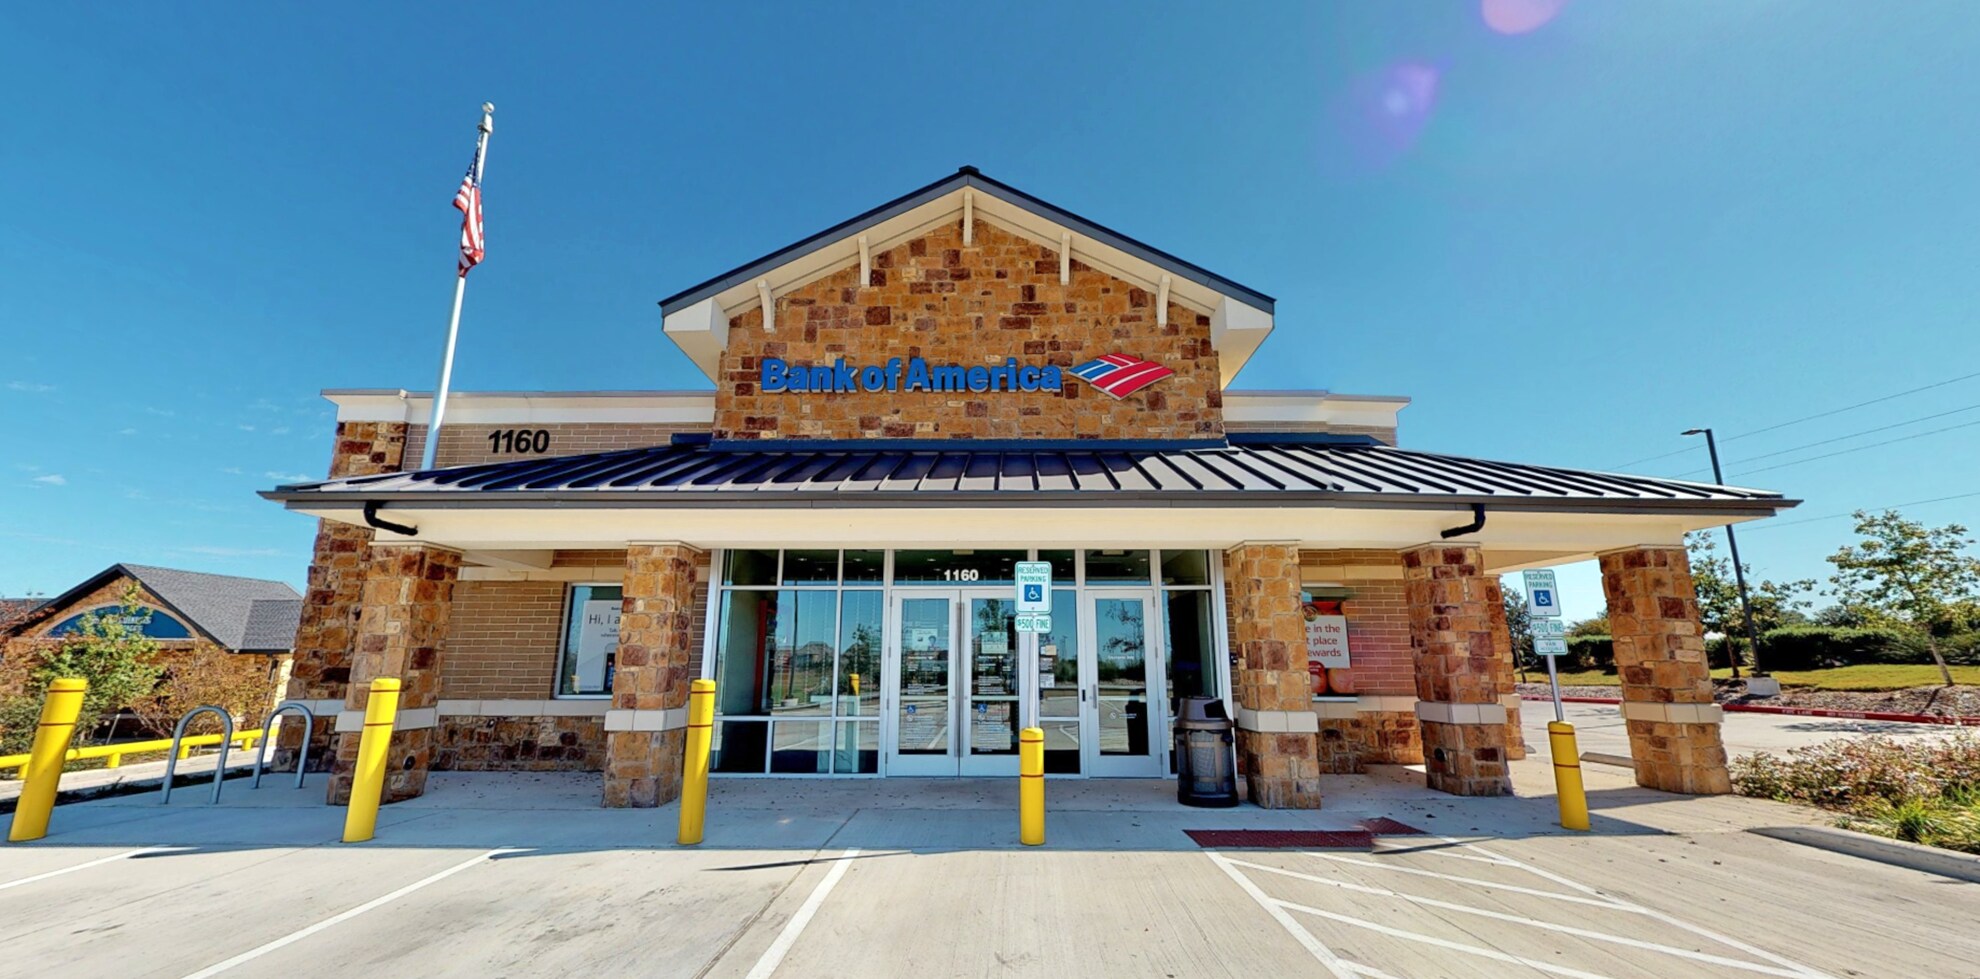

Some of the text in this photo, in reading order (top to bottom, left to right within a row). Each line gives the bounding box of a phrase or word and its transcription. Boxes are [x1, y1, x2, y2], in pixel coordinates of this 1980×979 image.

[761, 356, 1062, 393] Bank of America
[488, 429, 550, 453] 1160
[943, 569, 979, 581] 1160
[1017, 566, 1049, 574] RESERVED
[1525, 572, 1554, 580] RESERVED
[588, 614, 604, 626] Hi,
[1017, 618, 1049, 629] $500 FINE
[1313, 624, 1322, 632] in
[1325, 624, 1340, 632] the
[1313, 636, 1338, 646] place
[1307, 648, 1342, 657] ewards
